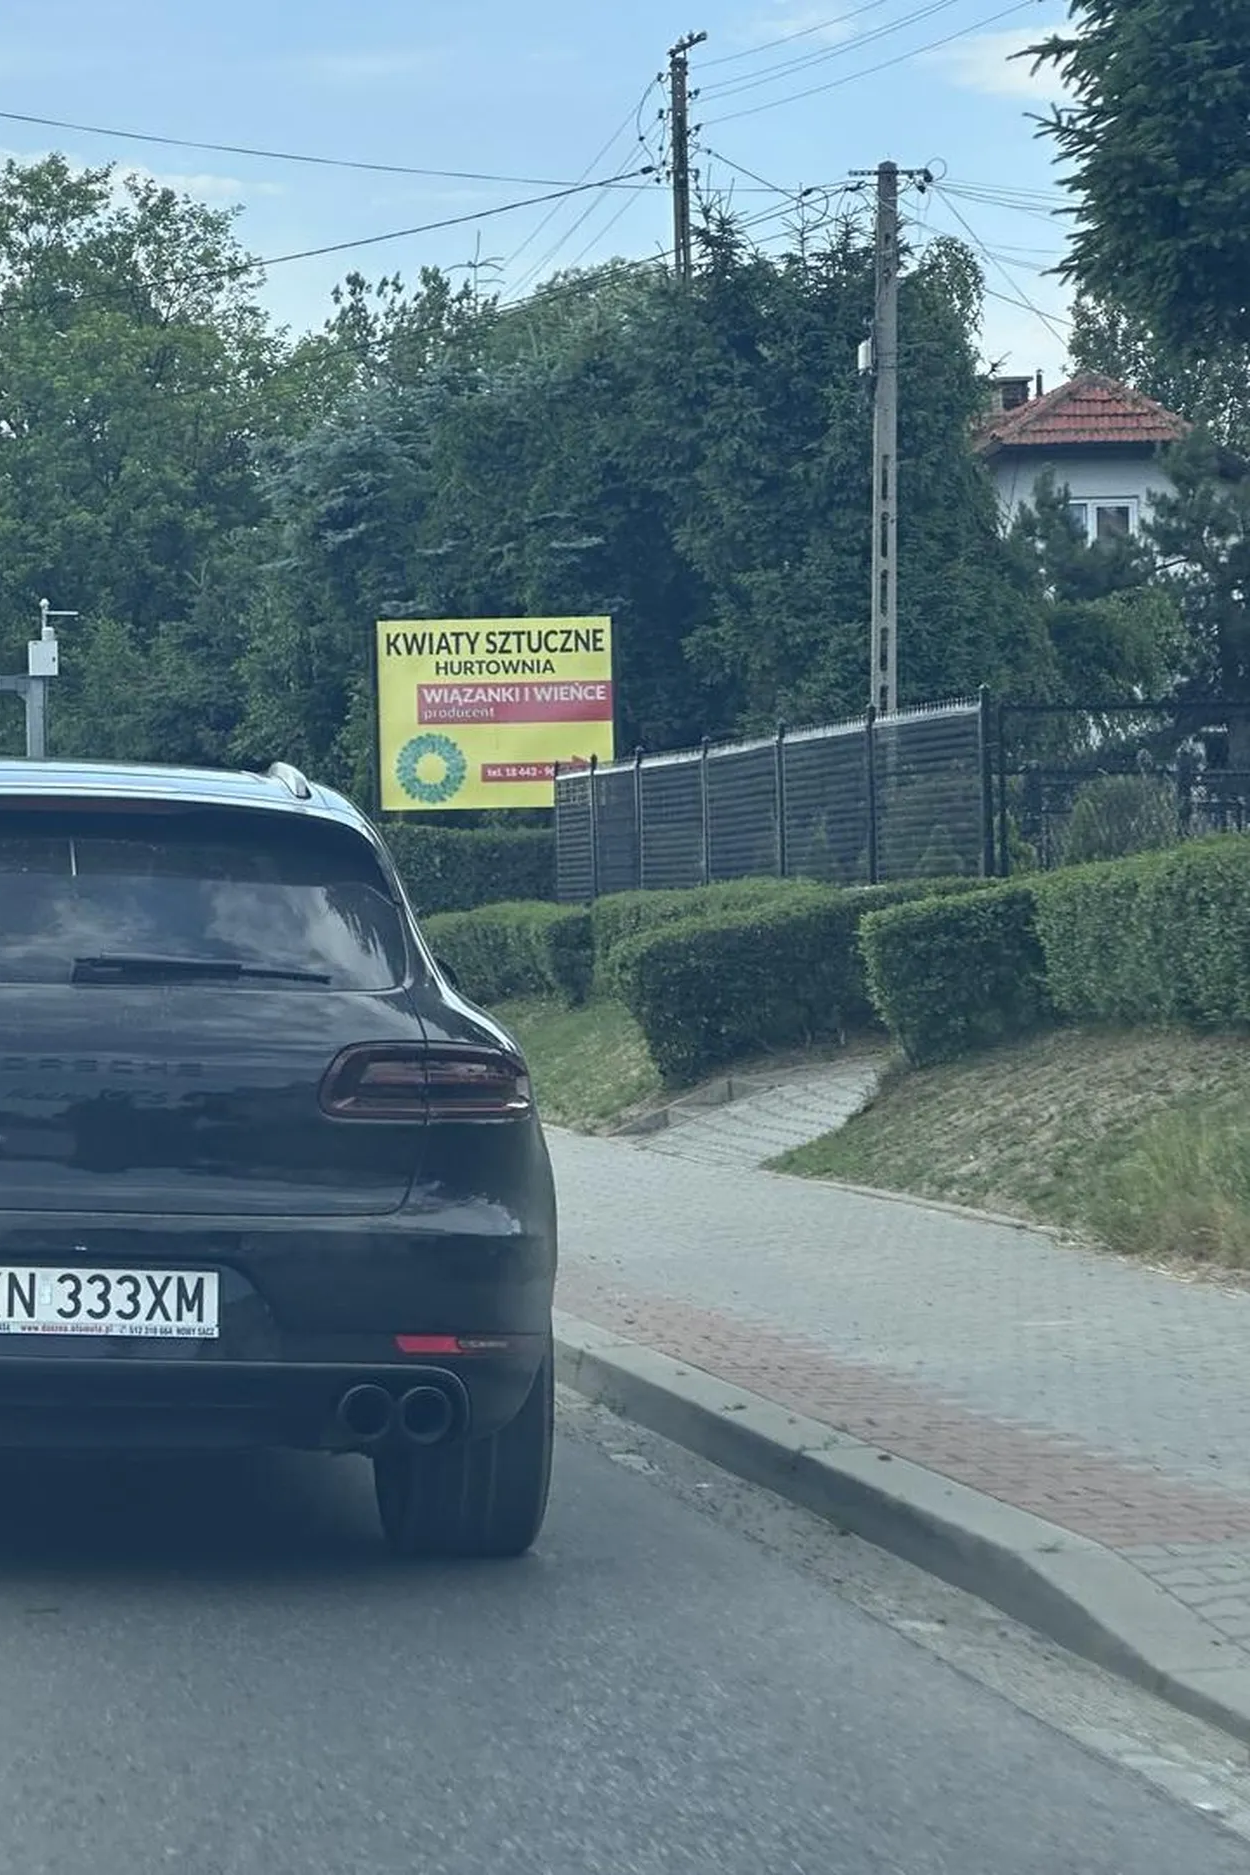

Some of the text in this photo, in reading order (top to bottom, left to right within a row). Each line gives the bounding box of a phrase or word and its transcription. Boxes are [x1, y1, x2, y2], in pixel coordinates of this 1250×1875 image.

[385, 628, 605, 656] KWIATY SZTUCZNE
[434, 658, 556, 676] HURTOWNIA
[422, 682, 607, 706] WIĄZANKI I WIEŃCE
[422, 706, 496, 721] producent
[56, 1273, 205, 1323] 333XM
